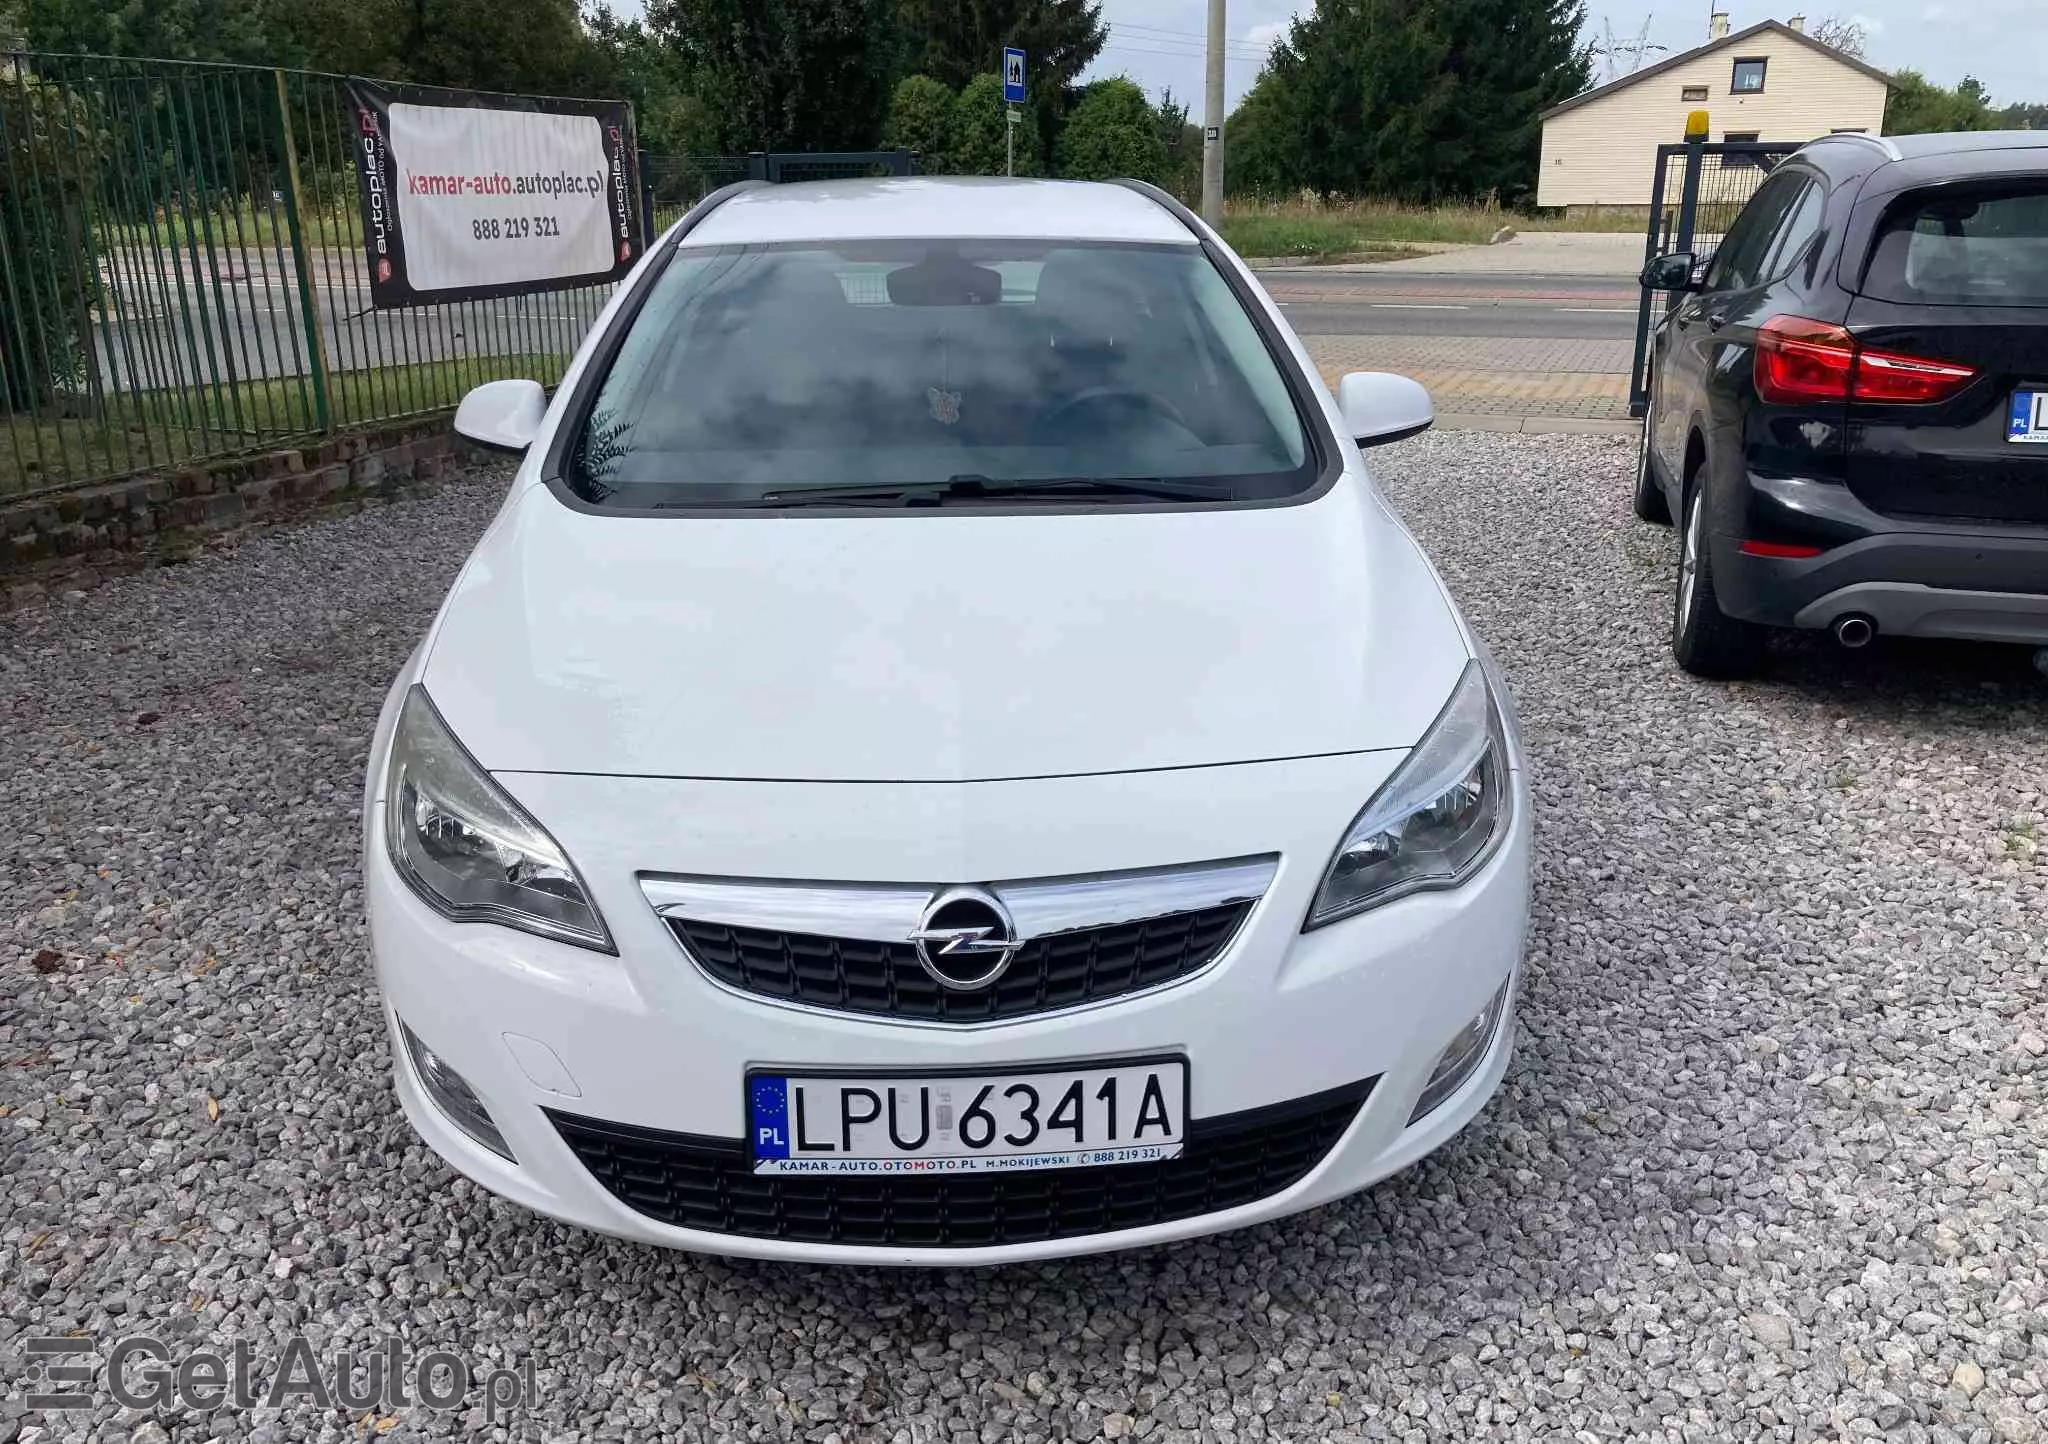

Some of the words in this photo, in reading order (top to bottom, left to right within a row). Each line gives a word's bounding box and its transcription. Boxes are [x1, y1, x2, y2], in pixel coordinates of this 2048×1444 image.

[406, 168, 603, 200] kamar-auto.autoplac.pl
[472, 219, 500, 240] 888
[505, 217, 529, 239] 219
[535, 216, 560, 236] 321
[2012, 418, 2027, 428] PL
[796, 1087, 930, 1151] LPU
[959, 1074, 1172, 1149] 6341A
[759, 1128, 785, 1144] PL
[1094, 1152, 1115, 1162] 888
[1118, 1150, 1138, 1161] 219
[1142, 1148, 1162, 1158] 321
